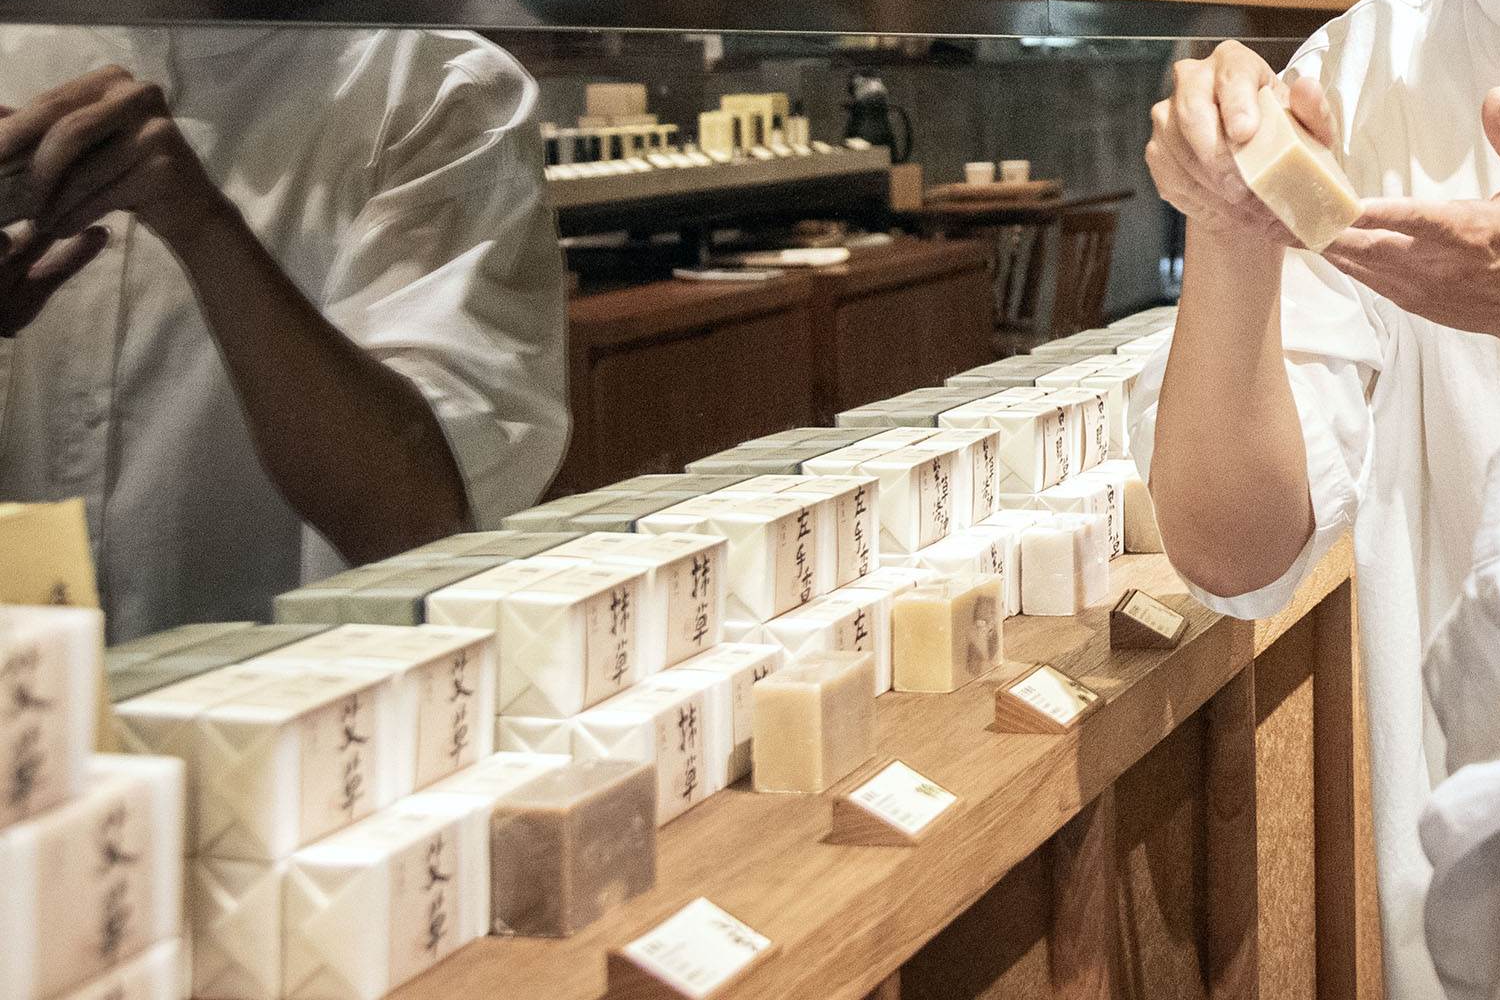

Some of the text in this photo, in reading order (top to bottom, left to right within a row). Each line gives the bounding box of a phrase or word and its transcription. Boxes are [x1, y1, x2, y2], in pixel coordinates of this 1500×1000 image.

[796, 506, 813, 604] 左手香
[853, 485, 869, 577] 左手香
